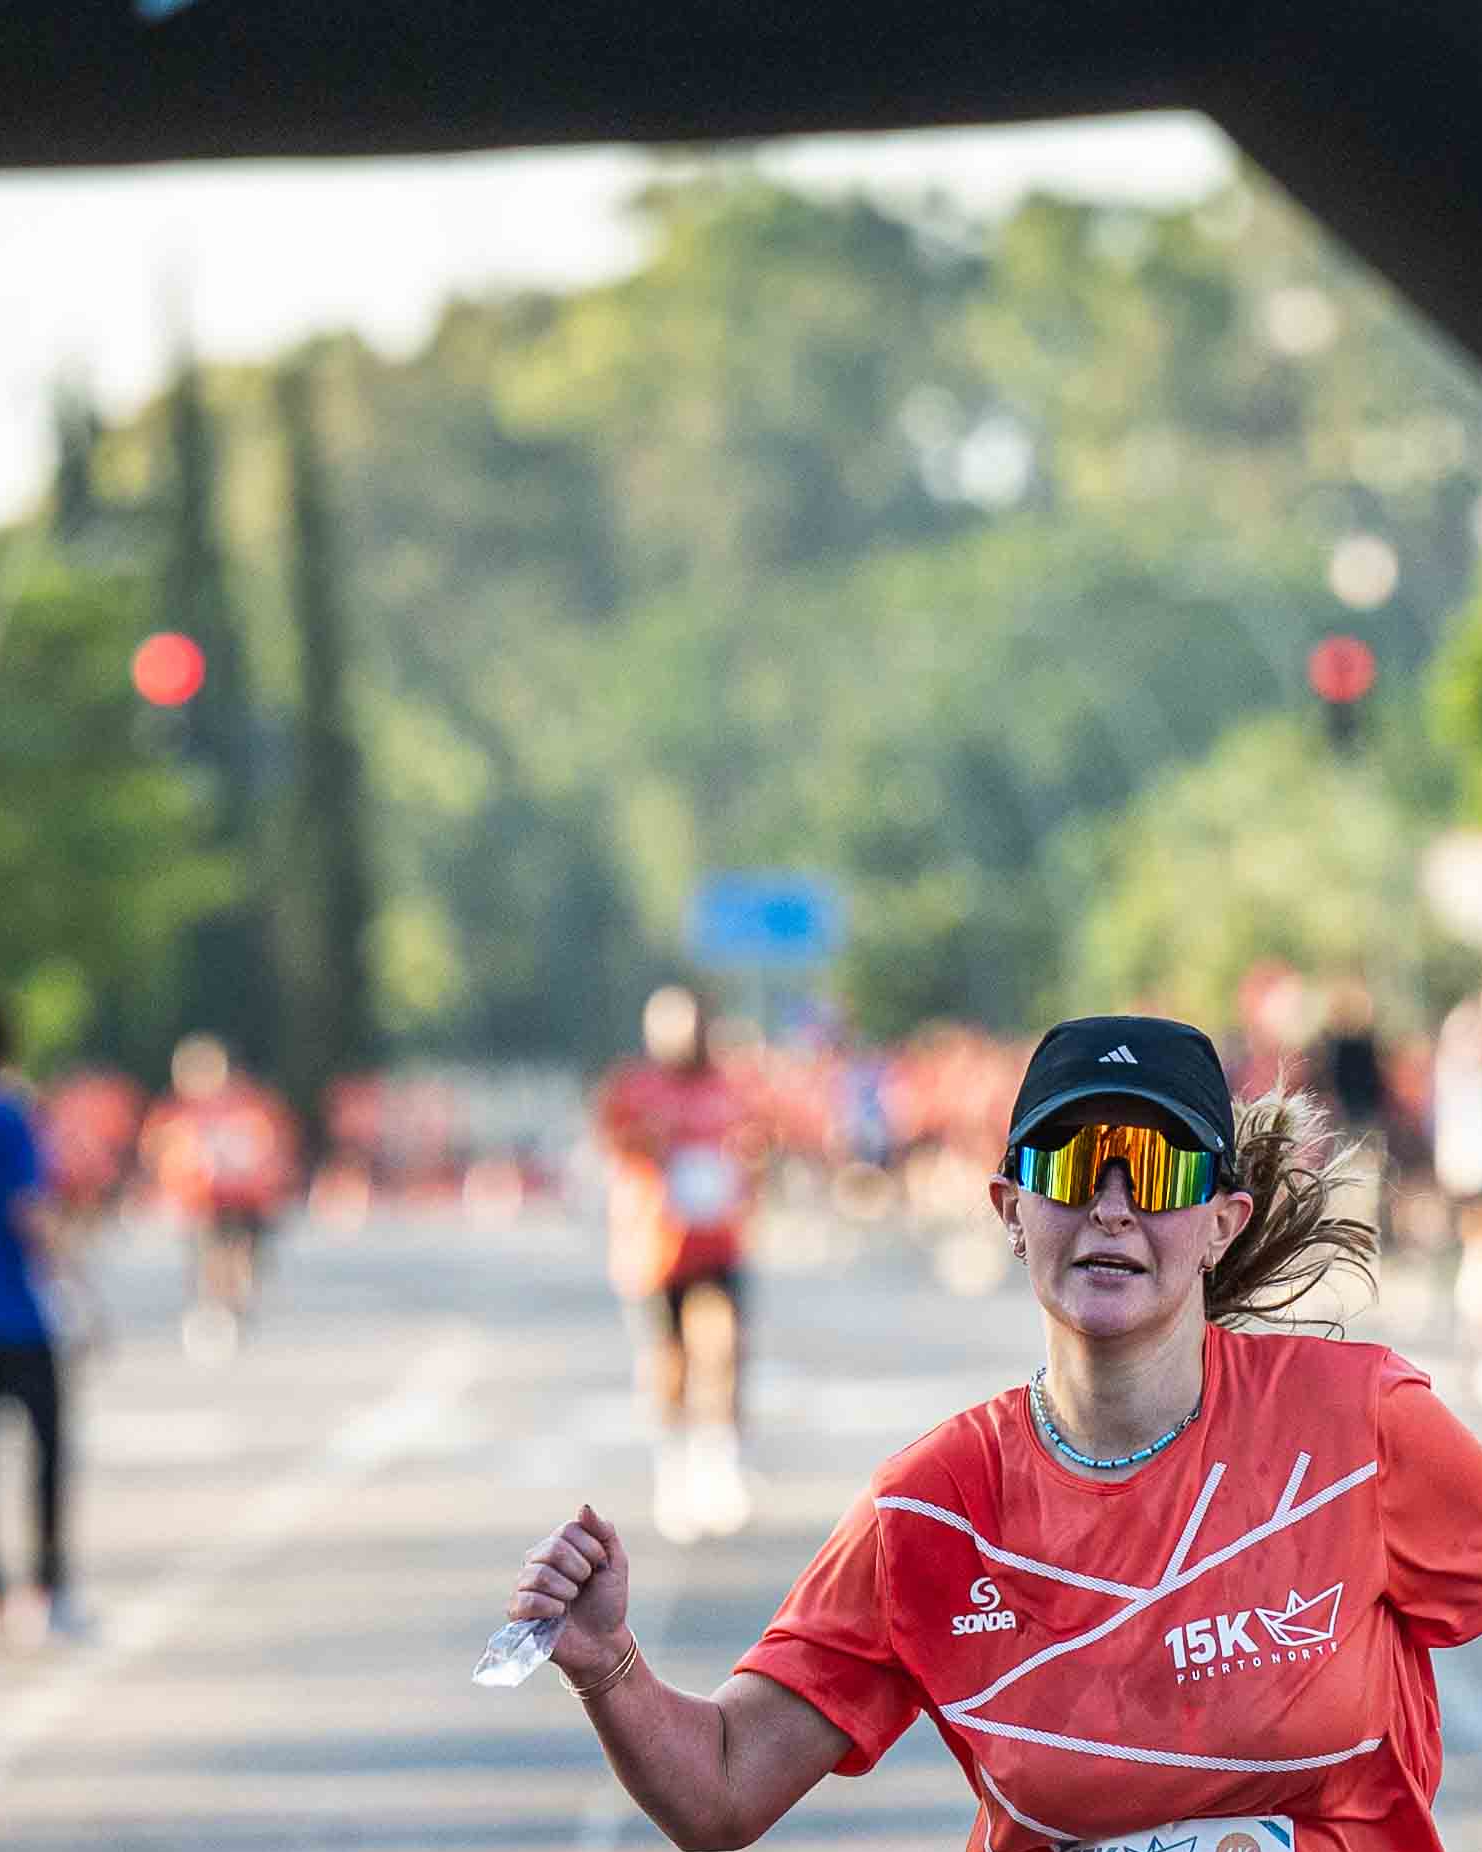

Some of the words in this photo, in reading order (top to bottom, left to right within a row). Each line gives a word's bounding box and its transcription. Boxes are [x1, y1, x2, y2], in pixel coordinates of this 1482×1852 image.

[1164, 1610, 1260, 1669] 15K
[1176, 1656, 1262, 1684] PUERTO
[1271, 1641, 1338, 1663] NORTE
